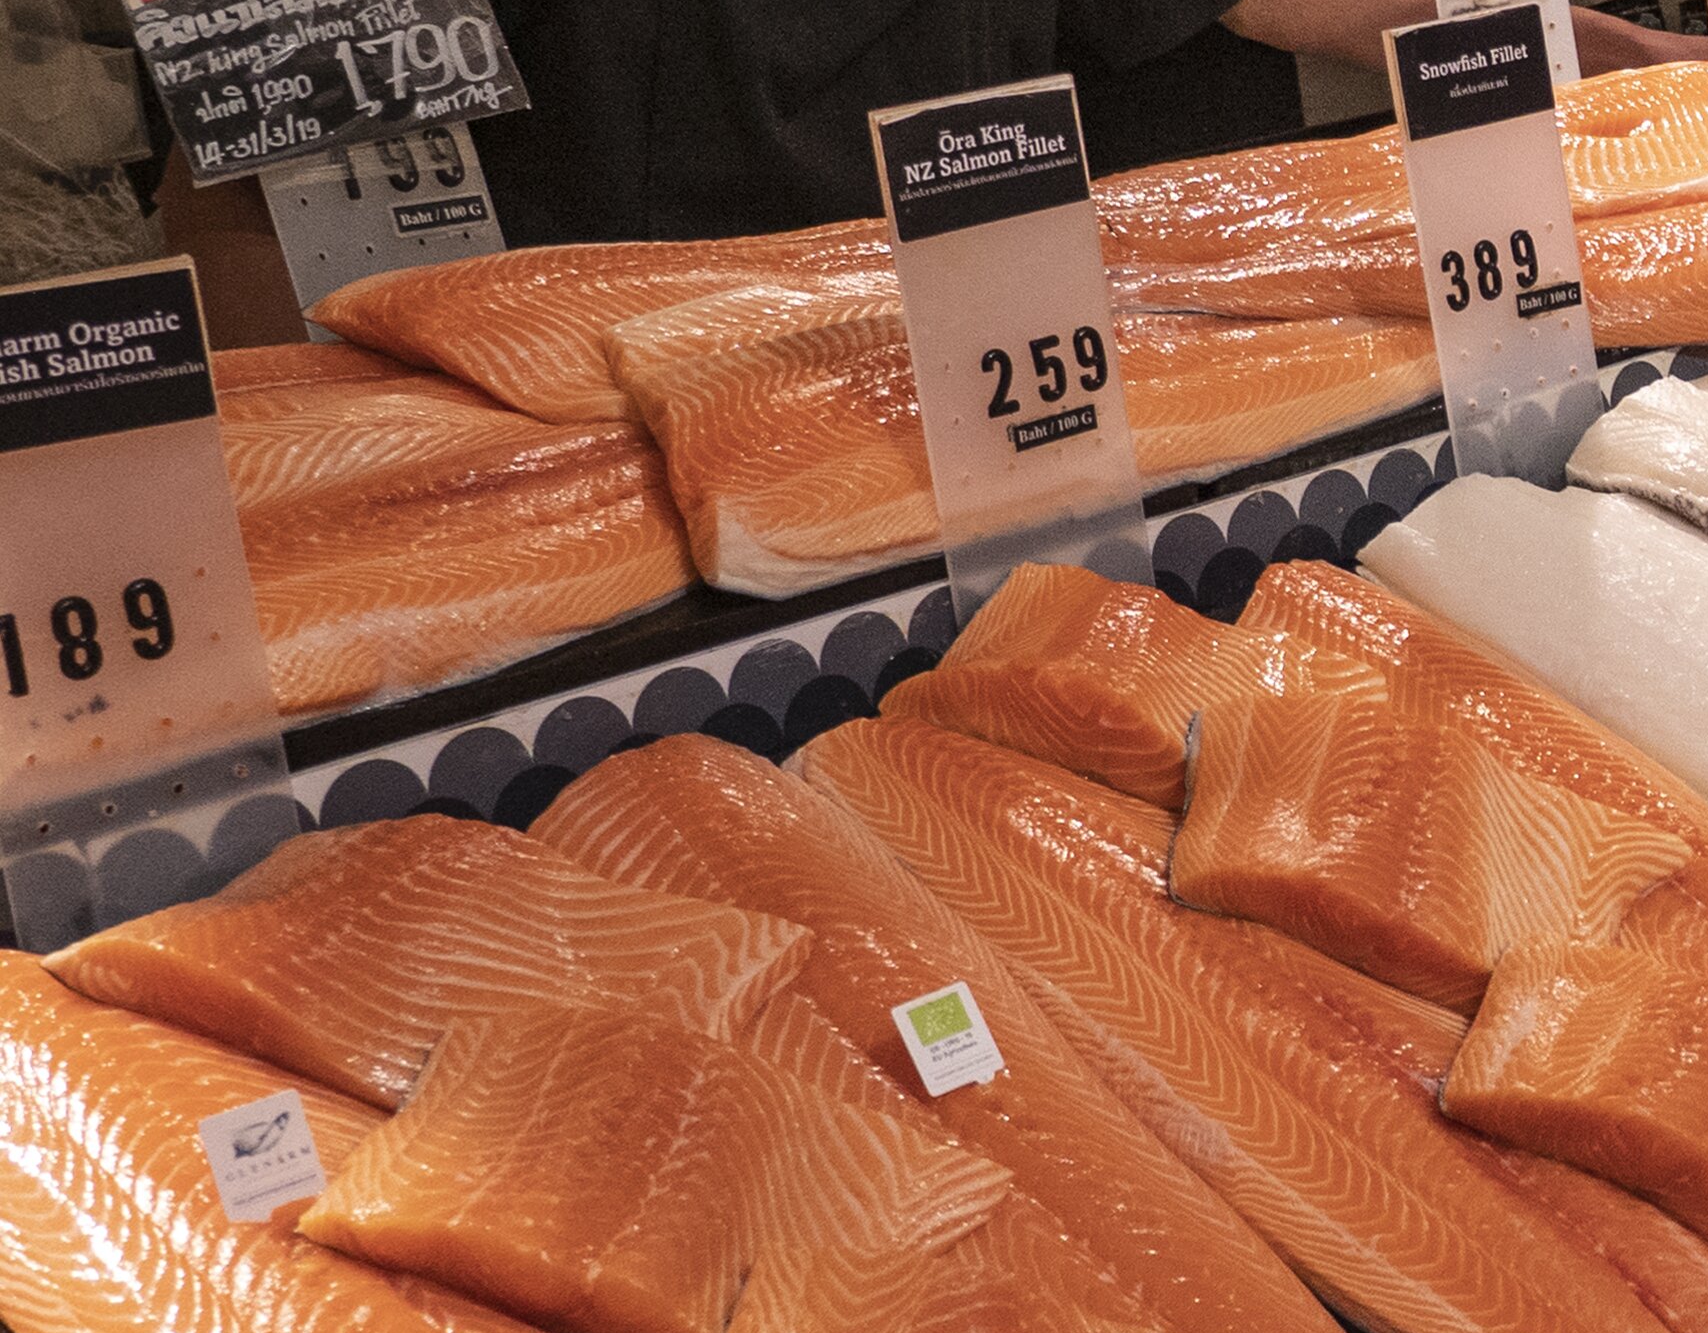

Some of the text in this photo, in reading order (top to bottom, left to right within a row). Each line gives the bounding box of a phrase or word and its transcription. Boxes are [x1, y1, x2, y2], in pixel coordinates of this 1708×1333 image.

[334, 16, 499, 118] 1,790
[1419, 43, 1529, 81] Snowfish Fillet
[252, 75, 313, 115] 1,990
[979, 123, 1027, 146] King
[903, 161, 941, 185] NZ
[940, 148, 1013, 177] Salmon
[1017, 134, 1067, 160] Fillet
[400, 209, 431, 227] Baht
[443, 205, 468, 222] 100
[468, 203, 482, 219] G
[1441, 229, 1538, 312] 389
[1520, 296, 1542, 311] Baht
[1550, 291, 1566, 305] 100
[1568, 288, 1577, 300] G
[68, 310, 181, 347] Organic
[47, 345, 156, 377] Salmon
[981, 326, 1108, 419] 259
[1018, 426, 1049, 444] Baht
[1057, 415, 1079, 432] 100
[1081, 411, 1093, 425] G
[0, 578, 175, 697] 189
